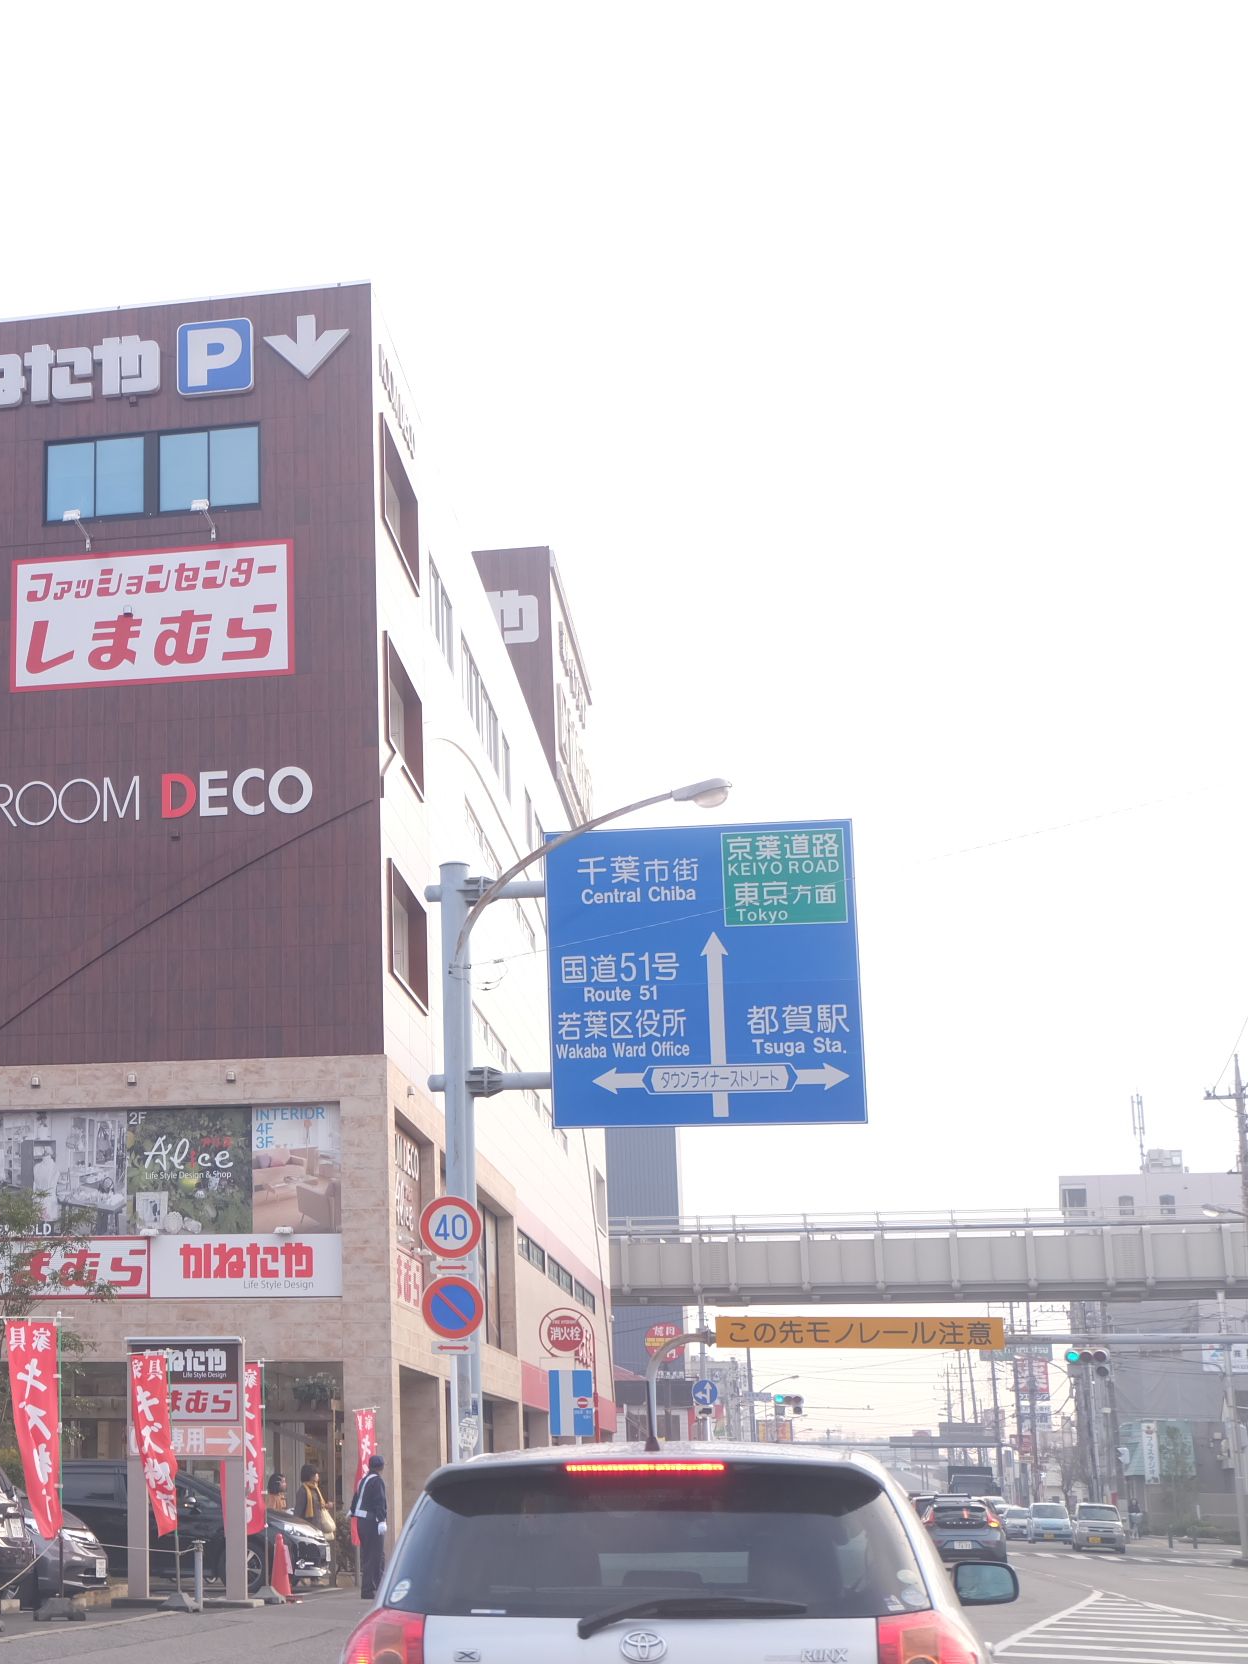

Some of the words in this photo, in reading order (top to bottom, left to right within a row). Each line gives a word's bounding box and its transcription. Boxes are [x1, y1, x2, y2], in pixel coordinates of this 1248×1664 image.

[187, 327, 243, 387] P
[26, 558, 277, 602] ファッションセンター
[25, 603, 278, 674] しまむら
[161, 766, 313, 818] DECO
[726, 833, 840, 861] 京葉道路
[577, 856, 699, 885] 千葉市街
[728, 861, 783, 876] KEIYO
[788, 859, 840, 874] ROAD
[581, 887, 641, 905] Central
[648, 886, 696, 902] Chiba
[734, 881, 837, 907] 東京方面
[736, 908, 789, 924] Tokyo
[561, 952, 680, 984] 国道51号
[584, 987, 631, 1003] Route
[639, 985, 658, 1001] 51
[557, 1008, 686, 1041] 若葉区役所
[746, 1004, 850, 1036] 都賀駅
[555, 1043, 607, 1059] Wakaba
[613, 1042, 646, 1058] Ward
[651, 1041, 690, 1057] Office
[751, 1038, 805, 1057] Tsuga
[812, 1037, 847, 1054] Sta.
[660, 1068, 780, 1089] タウンライナーストリート
[129, 1112, 147, 1125] 2F
[255, 1106, 326, 1121] INTERIOR
[255, 1122, 274, 1135] 4F
[143, 1134, 234, 1171] Alice
[255, 1136, 274, 1149] 3F
[145, 1171, 158, 1180] Life
[159, 1171, 177, 1180] Style
[179, 1171, 204, 1180] Design
[213, 1170, 232, 1180] Shop
[435, 1214, 467, 1241] 40
[179, 1242, 314, 1279] かねたや
[243, 1280, 259, 1290] Life
[260, 1280, 282, 1291] Style
[284, 1279, 314, 1291] Design
[550, 1326, 581, 1341] 消火栓
[729, 1320, 992, 1346] この先モノレール注意
[144, 1348, 227, 1372] ねたや
[182, 1371, 193, 1379] Life
[194, 1371, 207, 1380] Style
[208, 1371, 227, 1380] Design
